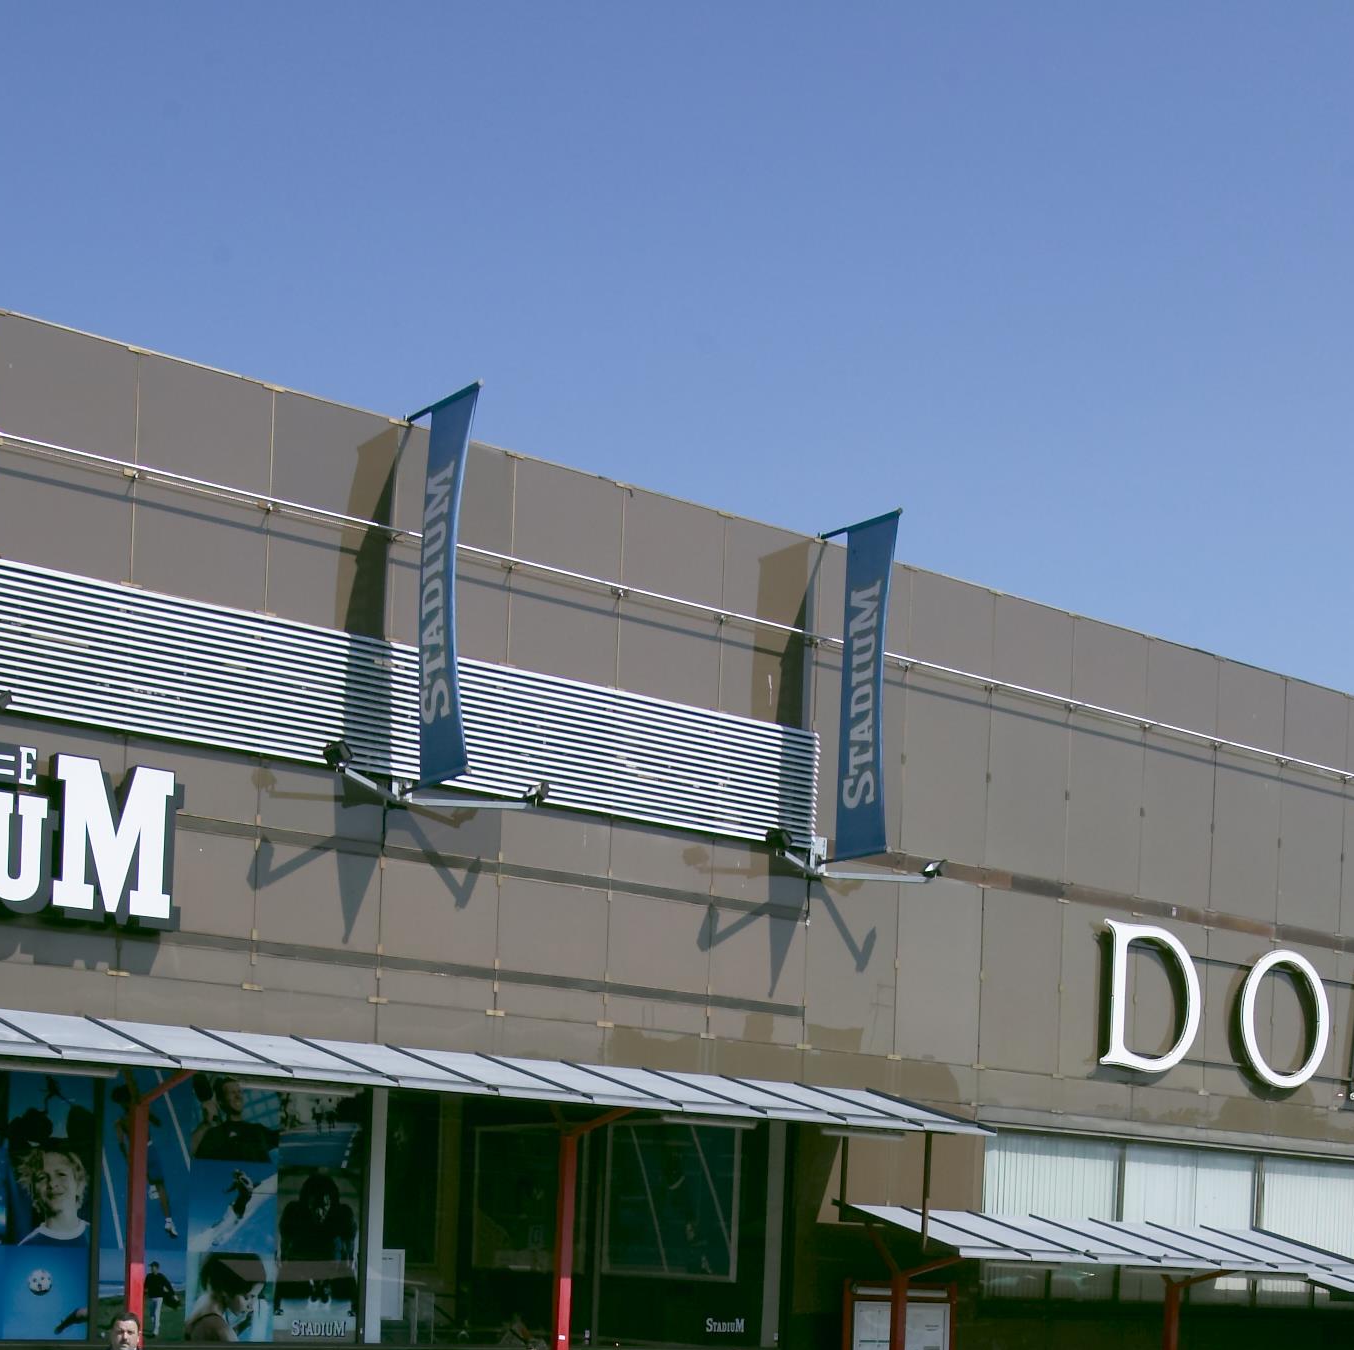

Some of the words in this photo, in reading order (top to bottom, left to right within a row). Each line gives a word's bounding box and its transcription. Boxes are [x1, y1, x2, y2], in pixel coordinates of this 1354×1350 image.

[421, 460, 455, 725] STADIUM
[842, 579, 882, 810] STADIUM
[292, 1319, 346, 1337] STADIUM
[705, 1317, 745, 1333] STADIUM
